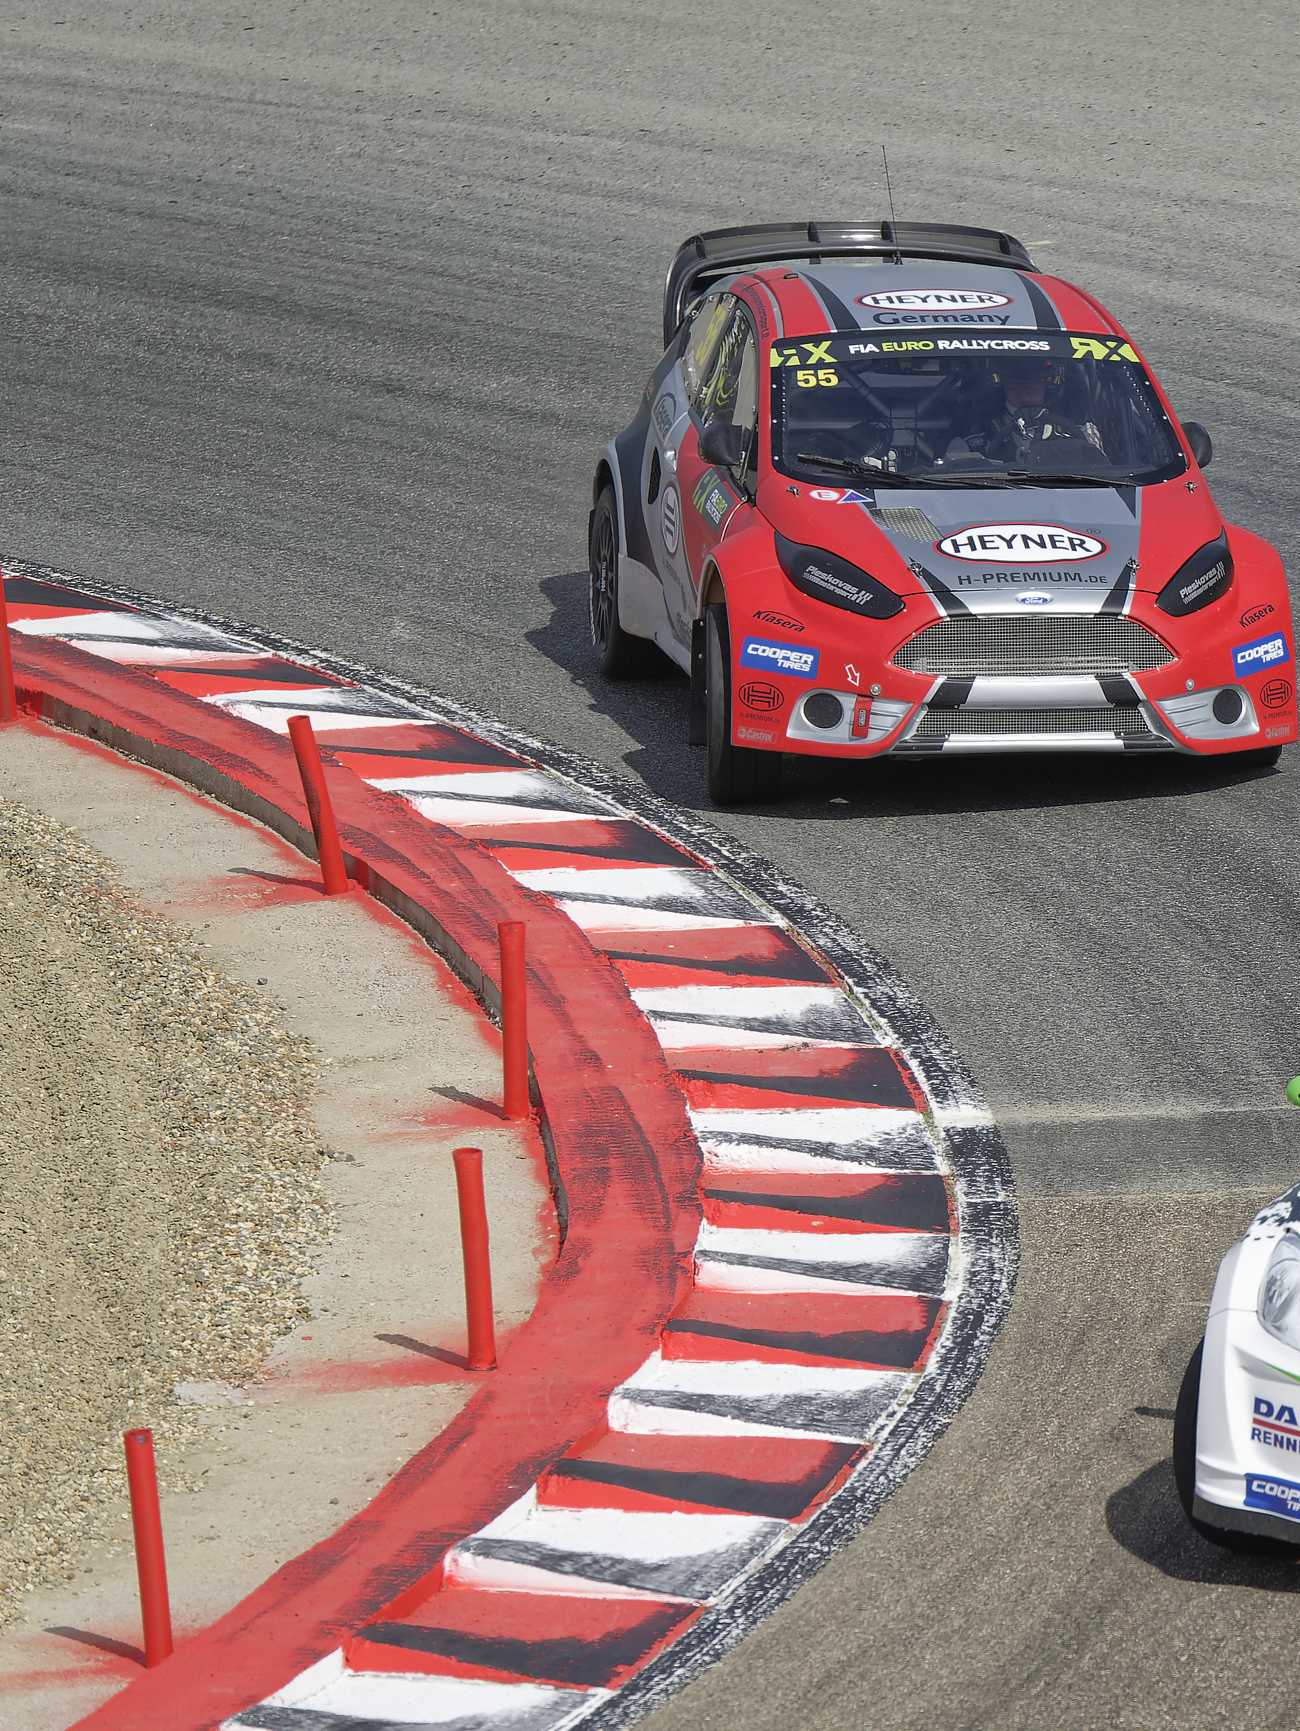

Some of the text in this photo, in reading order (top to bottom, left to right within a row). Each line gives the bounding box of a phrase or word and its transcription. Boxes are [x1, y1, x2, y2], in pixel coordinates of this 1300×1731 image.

[870, 294, 1000, 306] HEYNER
[873, 312, 1010, 326] Germany
[848, 343, 880, 354] FIA
[881, 341, 935, 353] EURO
[937, 339, 1051, 351] RALLYCROSS
[796, 368, 839, 389] 55
[950, 533, 1093, 554] HEYNER
[958, 572, 1108, 586] H-PREMIUM.DE
[747, 643, 814, 666] COOPER
[1237, 638, 1283, 664] COOPER
[1262, 650, 1285, 664] TIRES
[777, 658, 811, 673] TIRES
